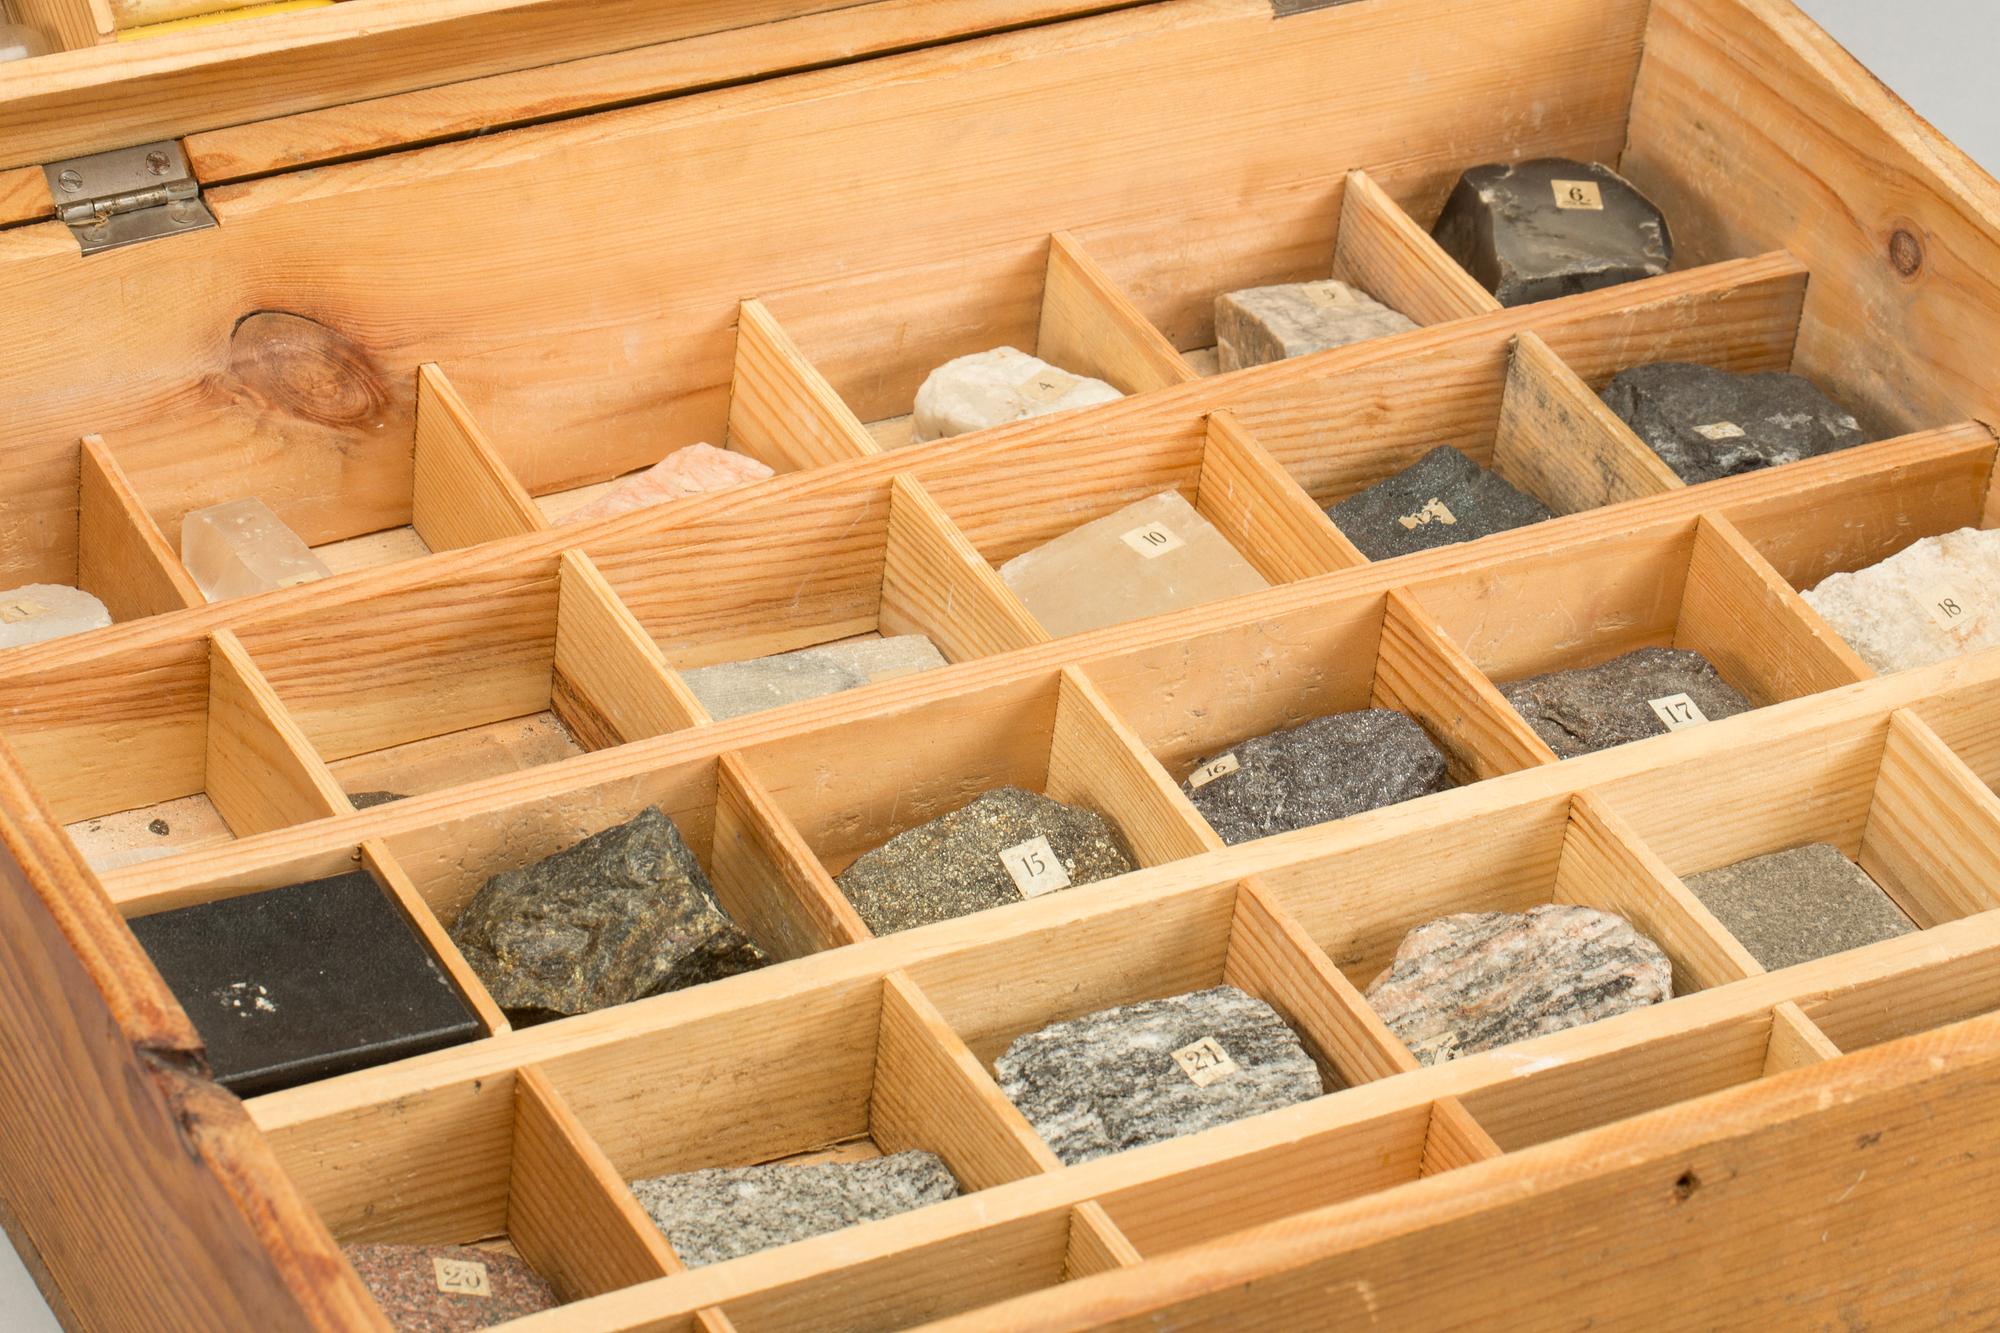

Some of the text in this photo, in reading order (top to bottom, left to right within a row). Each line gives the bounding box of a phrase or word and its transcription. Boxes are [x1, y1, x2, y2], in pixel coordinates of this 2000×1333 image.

[1321, 288, 1336, 301] 5
[1038, 381, 1055, 391] 4
[1142, 530, 1168, 547] 10
[1937, 598, 1962, 619] 18
[1663, 702, 1693, 724] 17
[1205, 764, 1227, 777] 16
[1021, 851, 1046, 878] 15
[1184, 1044, 1224, 1072] 21
[443, 1264, 481, 1289] 20
